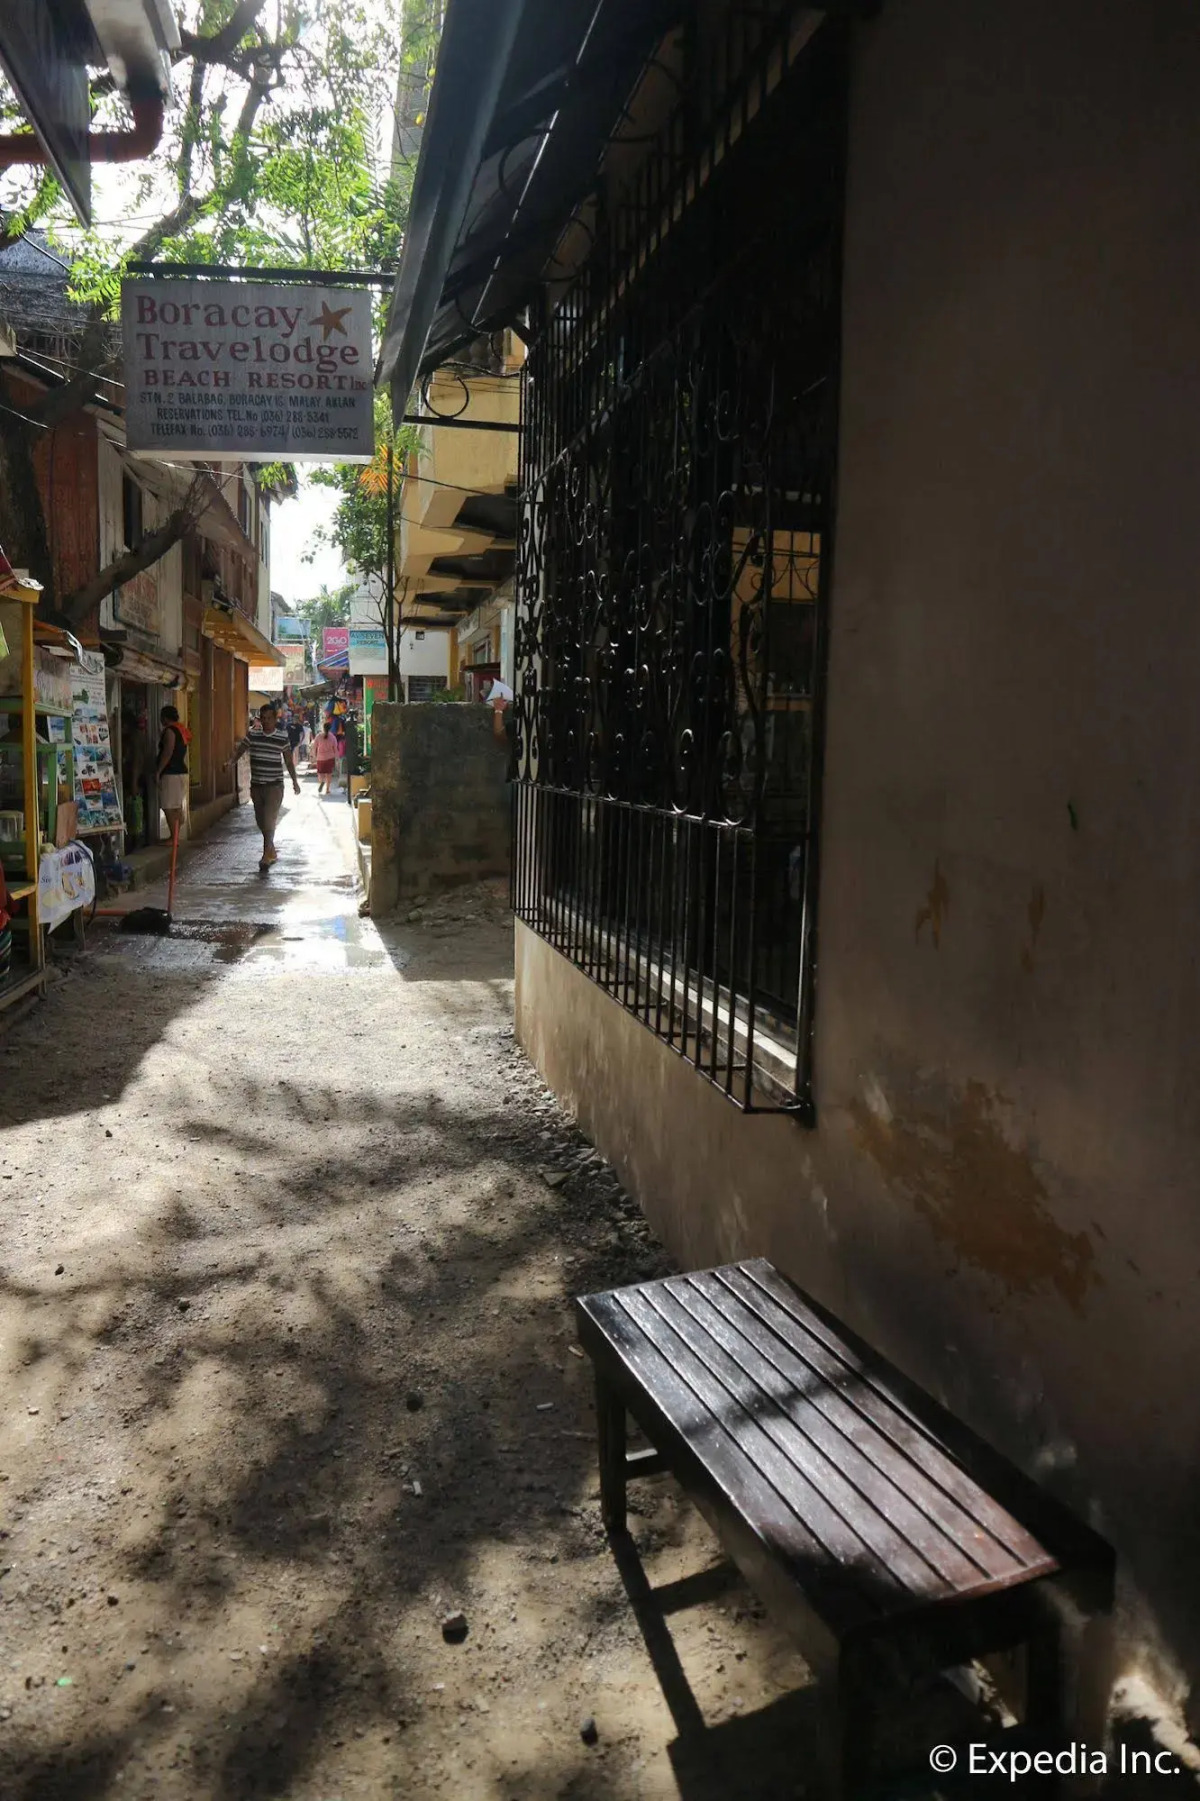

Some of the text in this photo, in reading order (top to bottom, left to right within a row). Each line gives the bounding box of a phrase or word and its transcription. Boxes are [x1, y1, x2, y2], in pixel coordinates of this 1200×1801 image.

[136, 295, 303, 338] Boracay
[136, 333, 360, 373] Travelodge
[144, 369, 232, 388] BEACH
[247, 372, 350, 390] RESORT
[168, 393, 175, 404] 2
[229, 394, 272, 407] BORACAY
[326, 396, 356, 408] AKLAN
[157, 407, 223, 421] RESERVATIONS
[258, 408, 283, 423] (036)
[151, 422, 187, 436] TELEFAX
[208, 423, 234, 437] (036)
